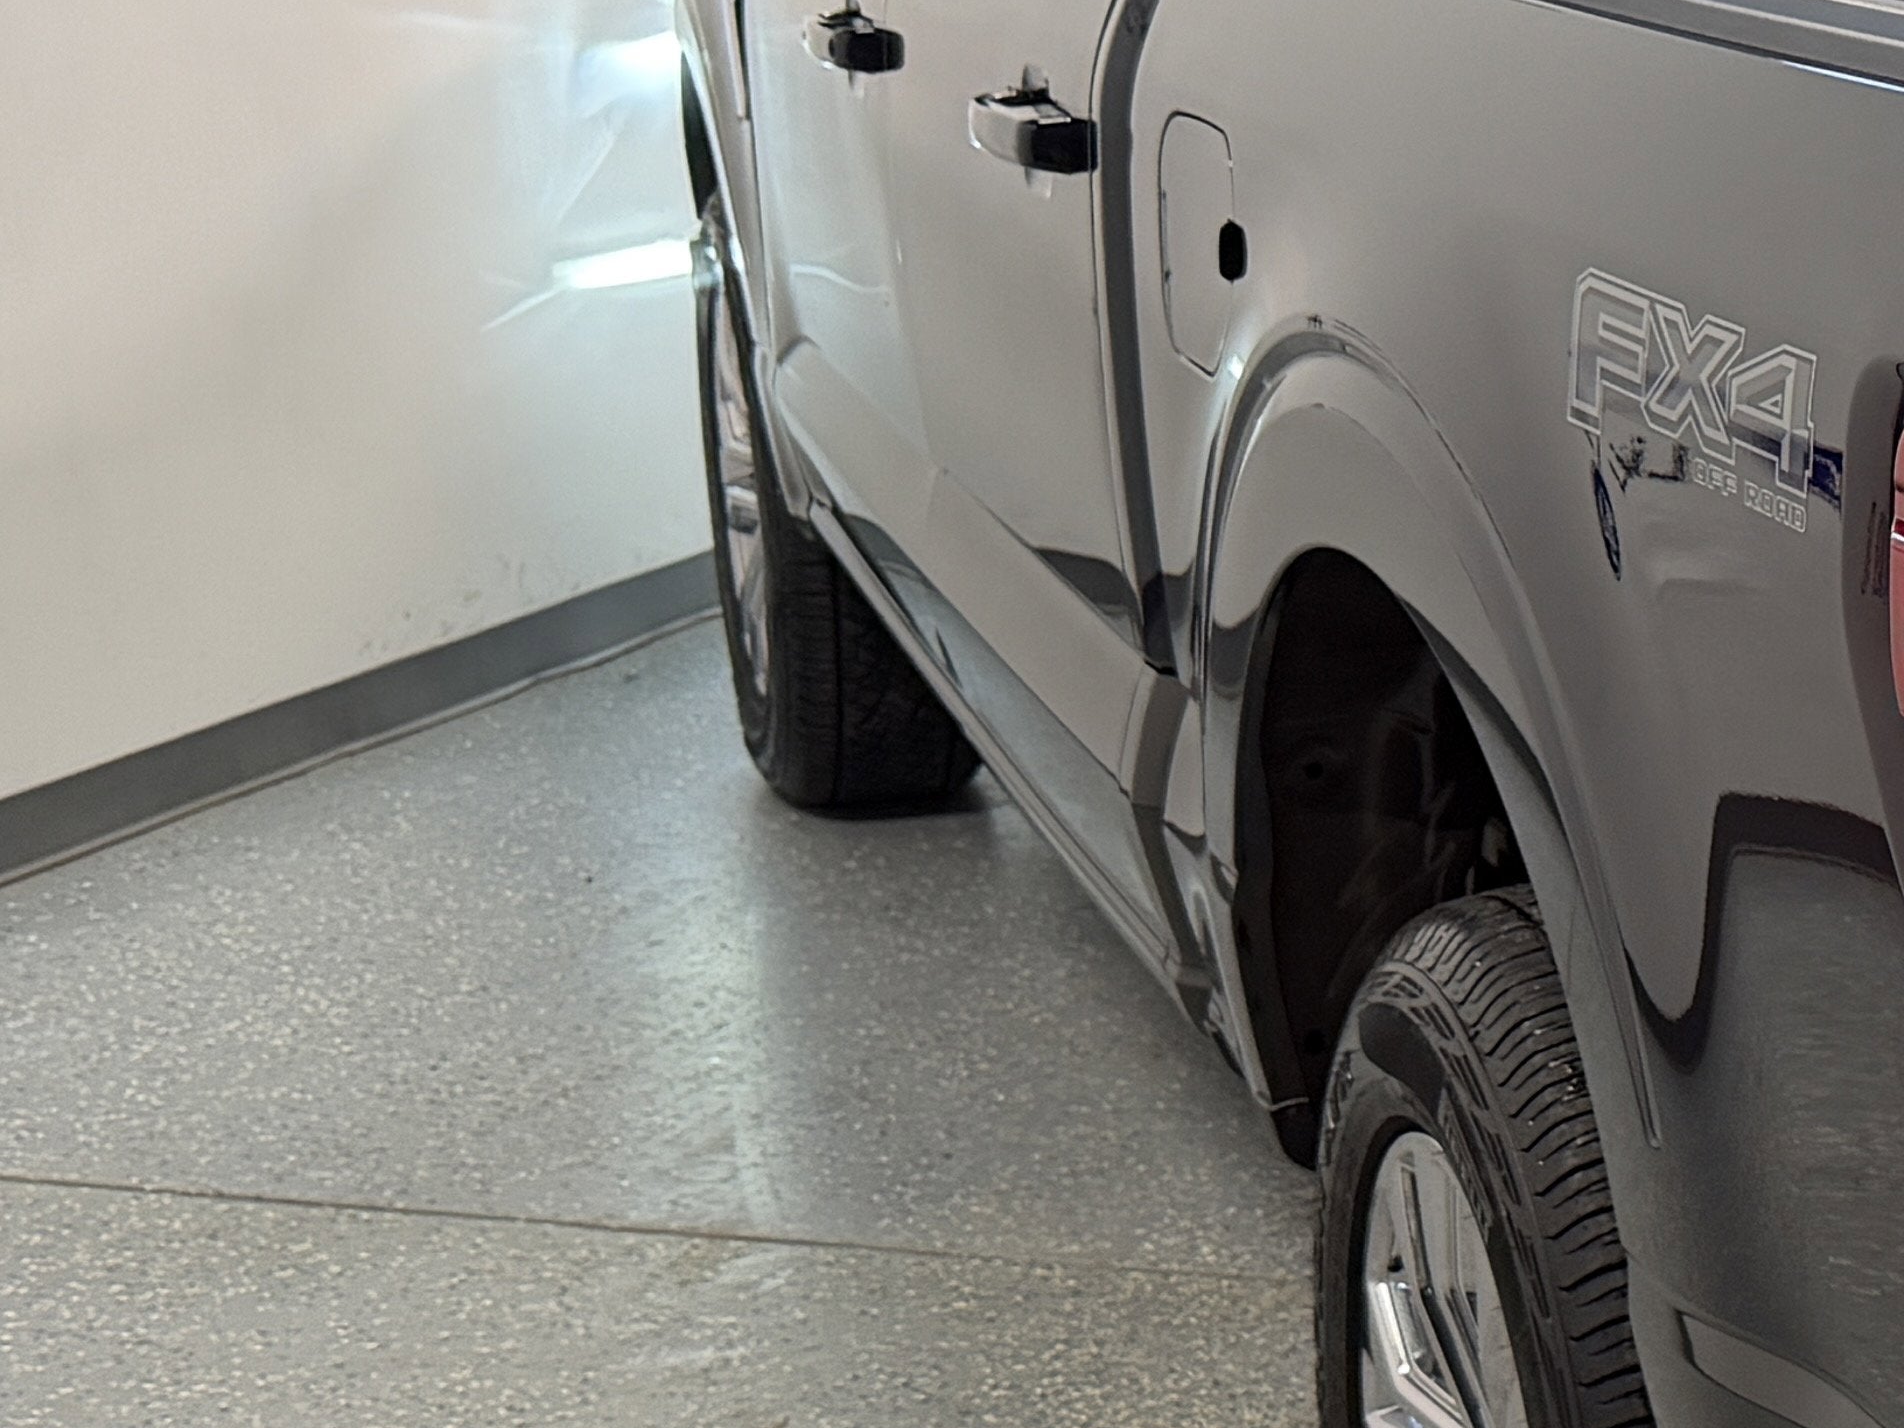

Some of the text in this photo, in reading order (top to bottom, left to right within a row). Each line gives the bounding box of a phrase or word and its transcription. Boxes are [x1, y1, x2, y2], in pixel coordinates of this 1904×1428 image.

[1566, 266, 1817, 499] FX4
[1692, 457, 1808, 534] OFF ROAD
